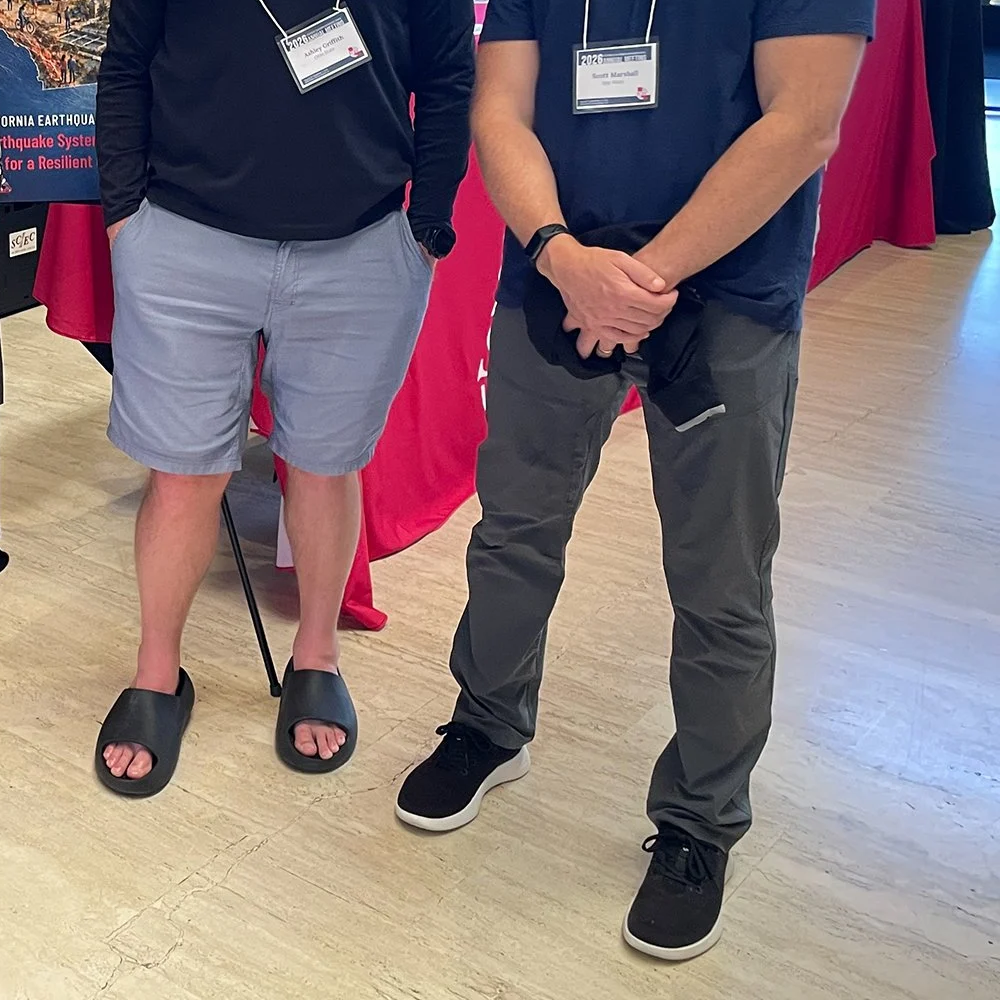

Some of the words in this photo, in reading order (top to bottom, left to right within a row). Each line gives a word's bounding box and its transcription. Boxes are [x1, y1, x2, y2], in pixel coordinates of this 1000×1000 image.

[289, 34, 309, 51] 2026
[581, 54, 603, 66] 2026
[5, 156, 23, 170] for
[27, 159, 35, 170] a
[38, 155, 93, 170] Resilient
